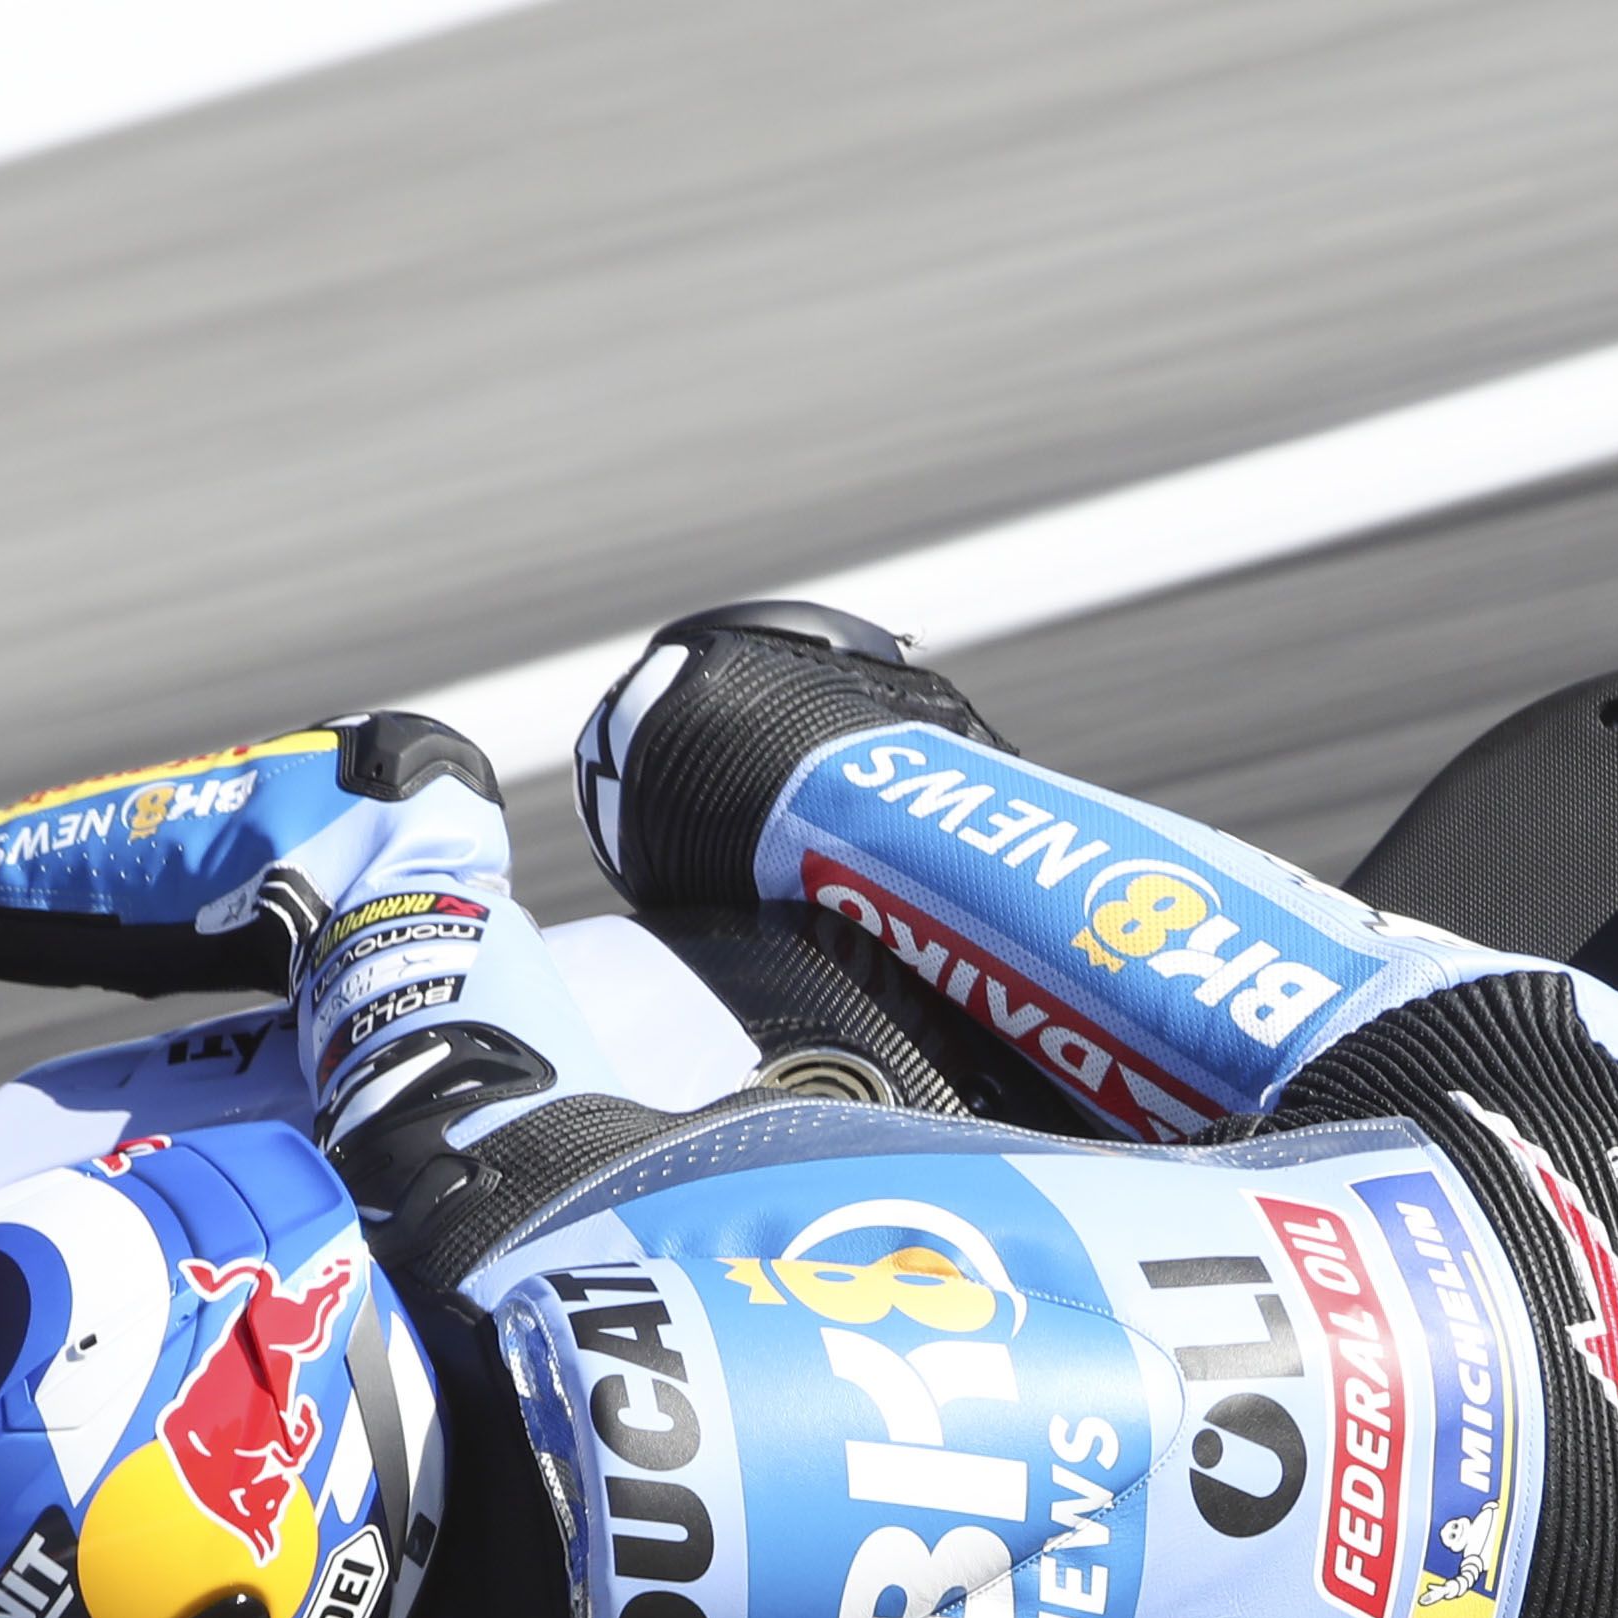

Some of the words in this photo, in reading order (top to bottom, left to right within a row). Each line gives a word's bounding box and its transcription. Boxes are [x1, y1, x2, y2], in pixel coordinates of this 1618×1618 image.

[129, 769, 258, 833] BK8
[841, 743, 1098, 892] NEWS
[351, 985, 454, 1046] BOLD
[1091, 870, 1343, 1047] BK8
[1286, 1214, 1363, 1298] OIL
[1395, 1202, 1496, 1493] MICHELIN
[1334, 1307, 1394, 1597] FEDERAL
